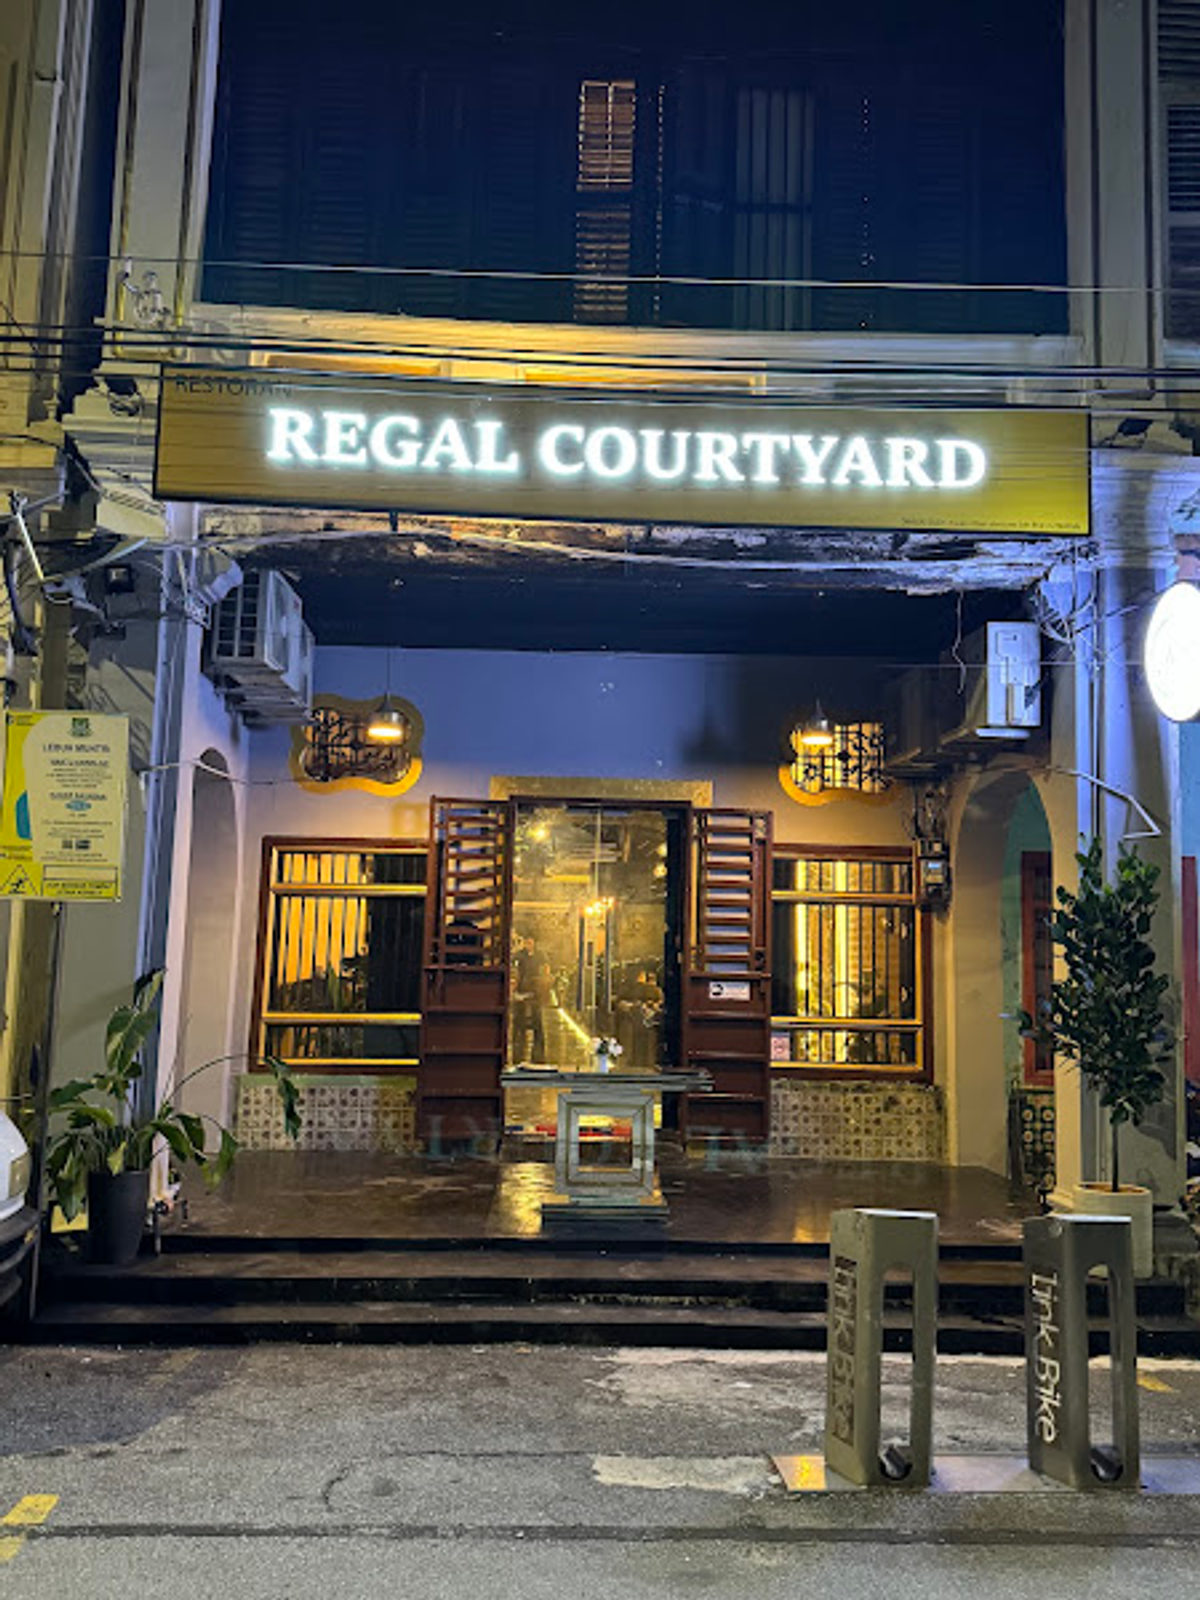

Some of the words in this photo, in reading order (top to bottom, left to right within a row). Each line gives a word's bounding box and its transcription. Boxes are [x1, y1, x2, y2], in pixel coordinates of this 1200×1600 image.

[265, 407, 520, 474] REGAL
[538, 424, 988, 489] COURTYARD
[1031, 1272, 1060, 1348] Link
[1035, 1355, 1062, 1443] Bike
